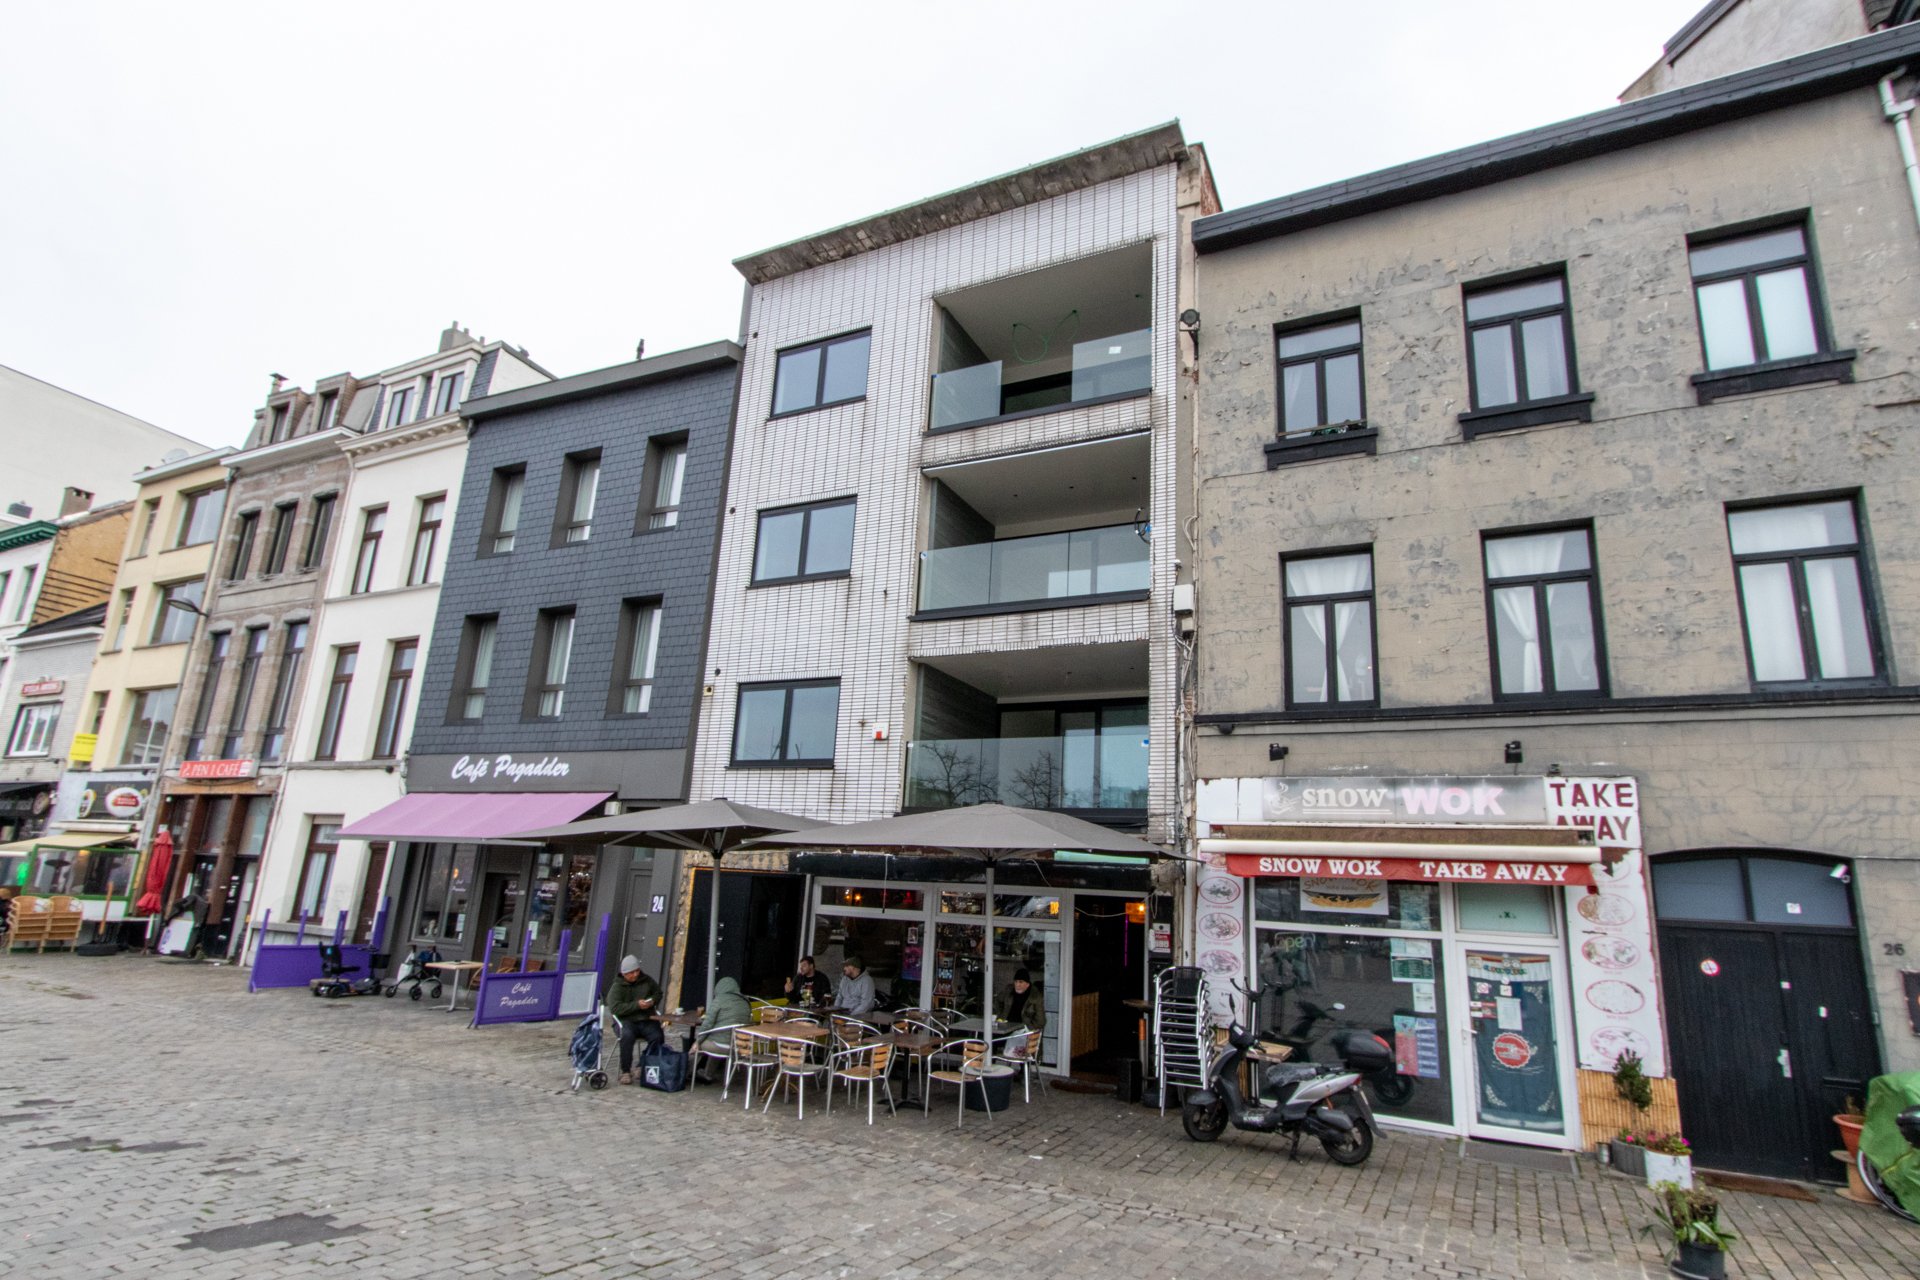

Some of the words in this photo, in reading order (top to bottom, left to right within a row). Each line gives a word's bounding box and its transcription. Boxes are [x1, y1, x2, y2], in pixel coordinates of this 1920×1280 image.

[451, 755, 489, 783] Café
[493, 754, 570, 783] Pagadder
[1302, 787, 1389, 808] snow
[1401, 786, 1506, 816] WOK
[1549, 783, 1634, 808] TAKE
[1259, 857, 1322, 875] SNOW
[1327, 858, 1383, 876] WOK
[1419, 861, 1487, 879] TAKE
[1493, 863, 1568, 882] AWAY
[1304, 877, 1333, 890] SNO
[652, 895, 665, 913] 24
[1883, 943, 1906, 956] 26
[511, 982, 532, 994] Café
[500, 996, 539, 1008] Pagadder
